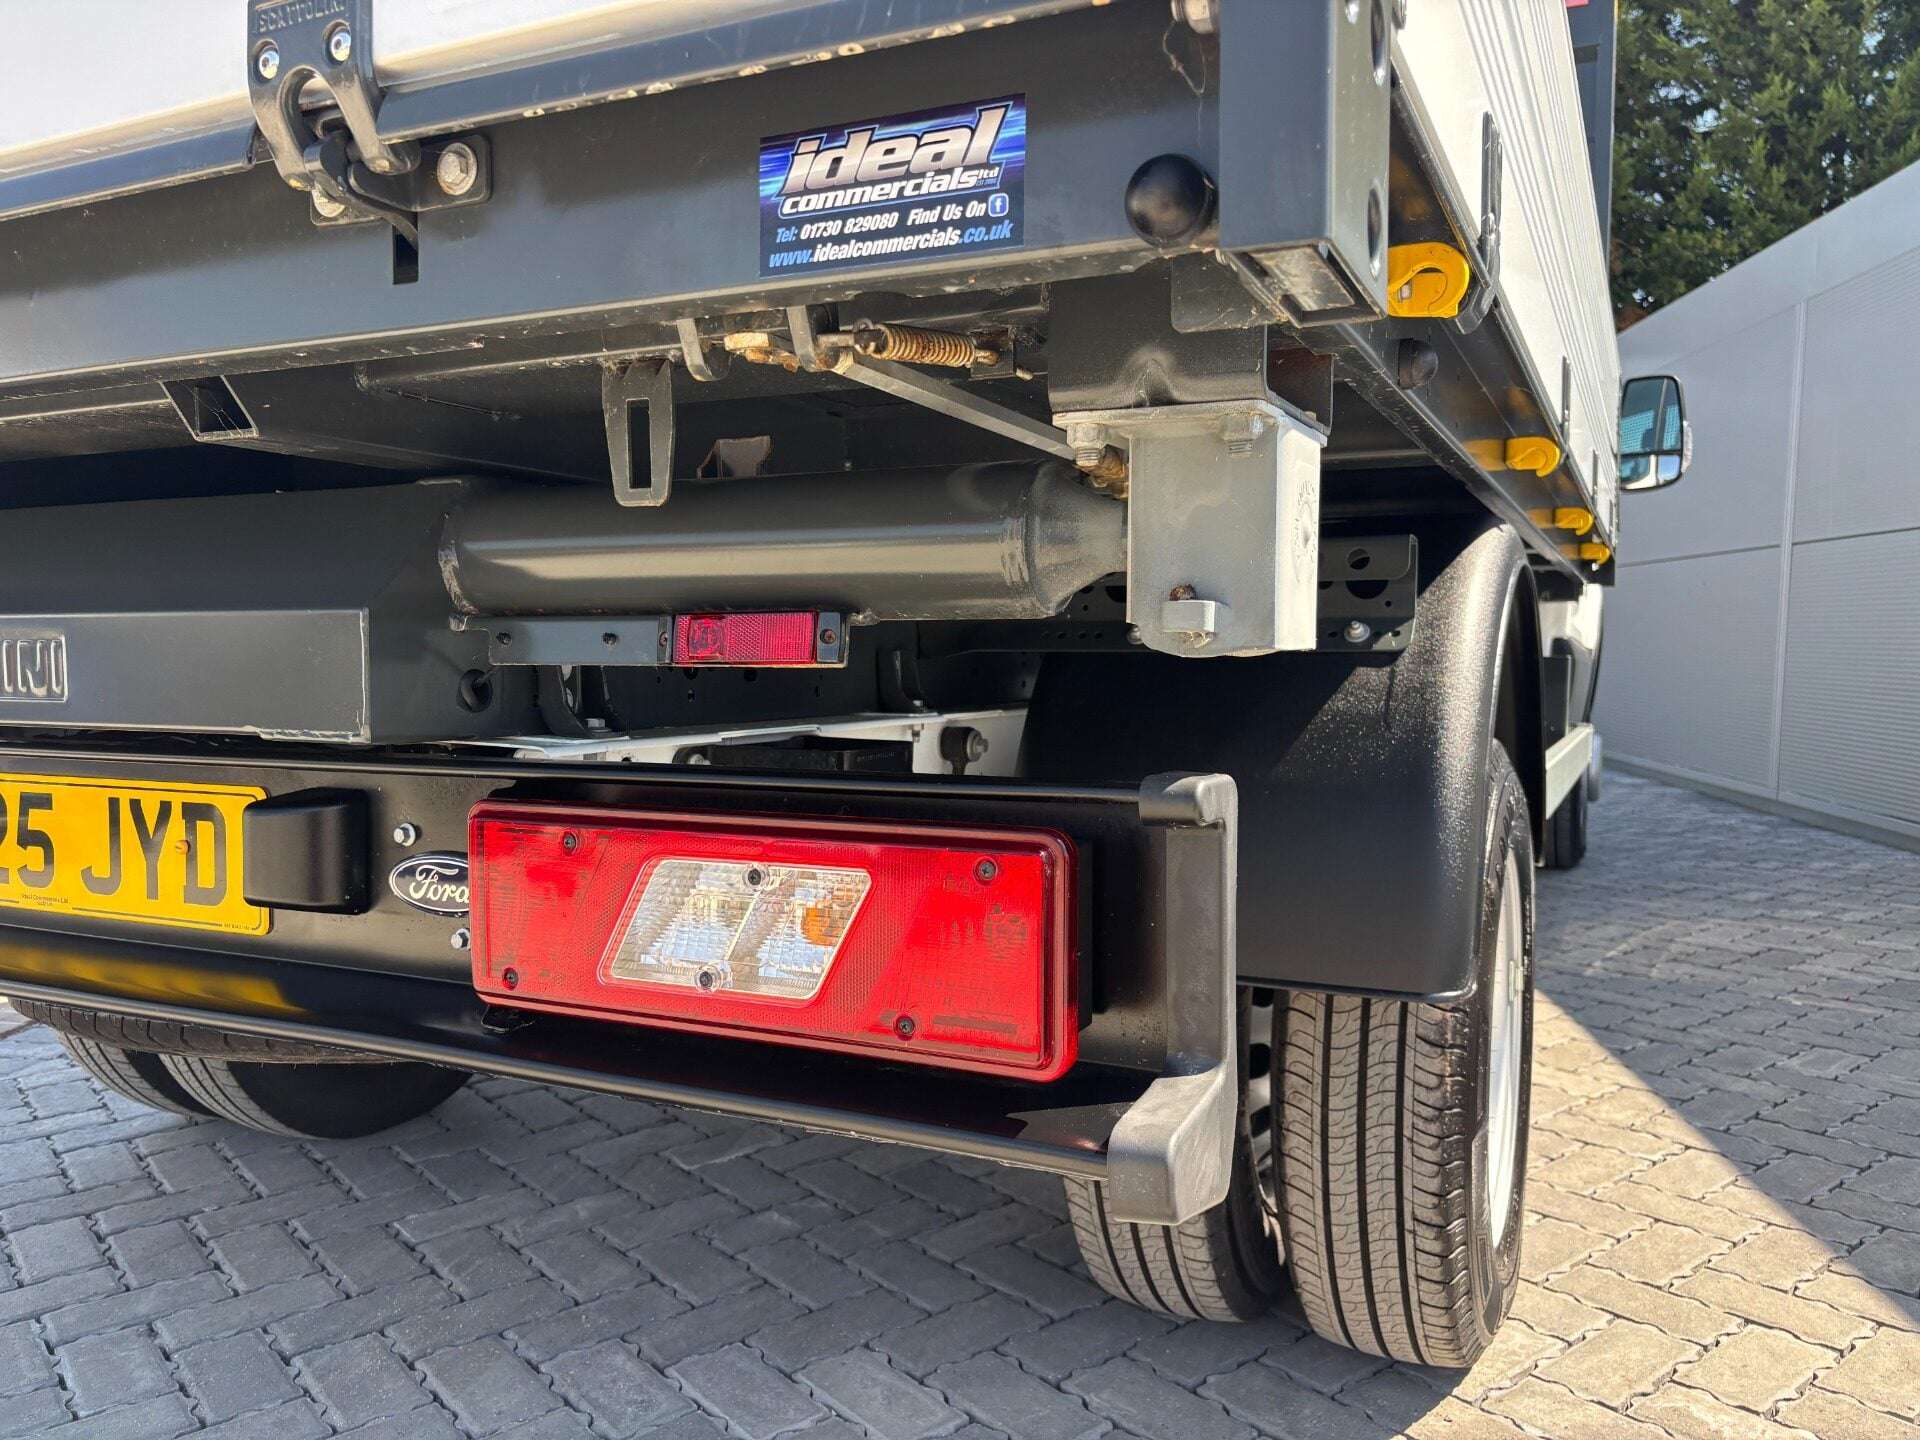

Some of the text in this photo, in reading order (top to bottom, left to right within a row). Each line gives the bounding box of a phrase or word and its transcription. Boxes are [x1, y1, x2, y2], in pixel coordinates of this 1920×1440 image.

[780, 103, 1011, 195] ideal
[781, 166, 1000, 215] commercials ltd
[768, 219, 1014, 268] www.idealcommercials.co.uk
[775, 227, 799, 244] Tel:
[800, 220, 842, 240] 01730
[844, 212, 899, 235] 829080
[907, 205, 941, 226] Find
[942, 203, 963, 221] Us
[965, 200, 987, 218] On
[0, 791, 228, 906] 5 JYD
